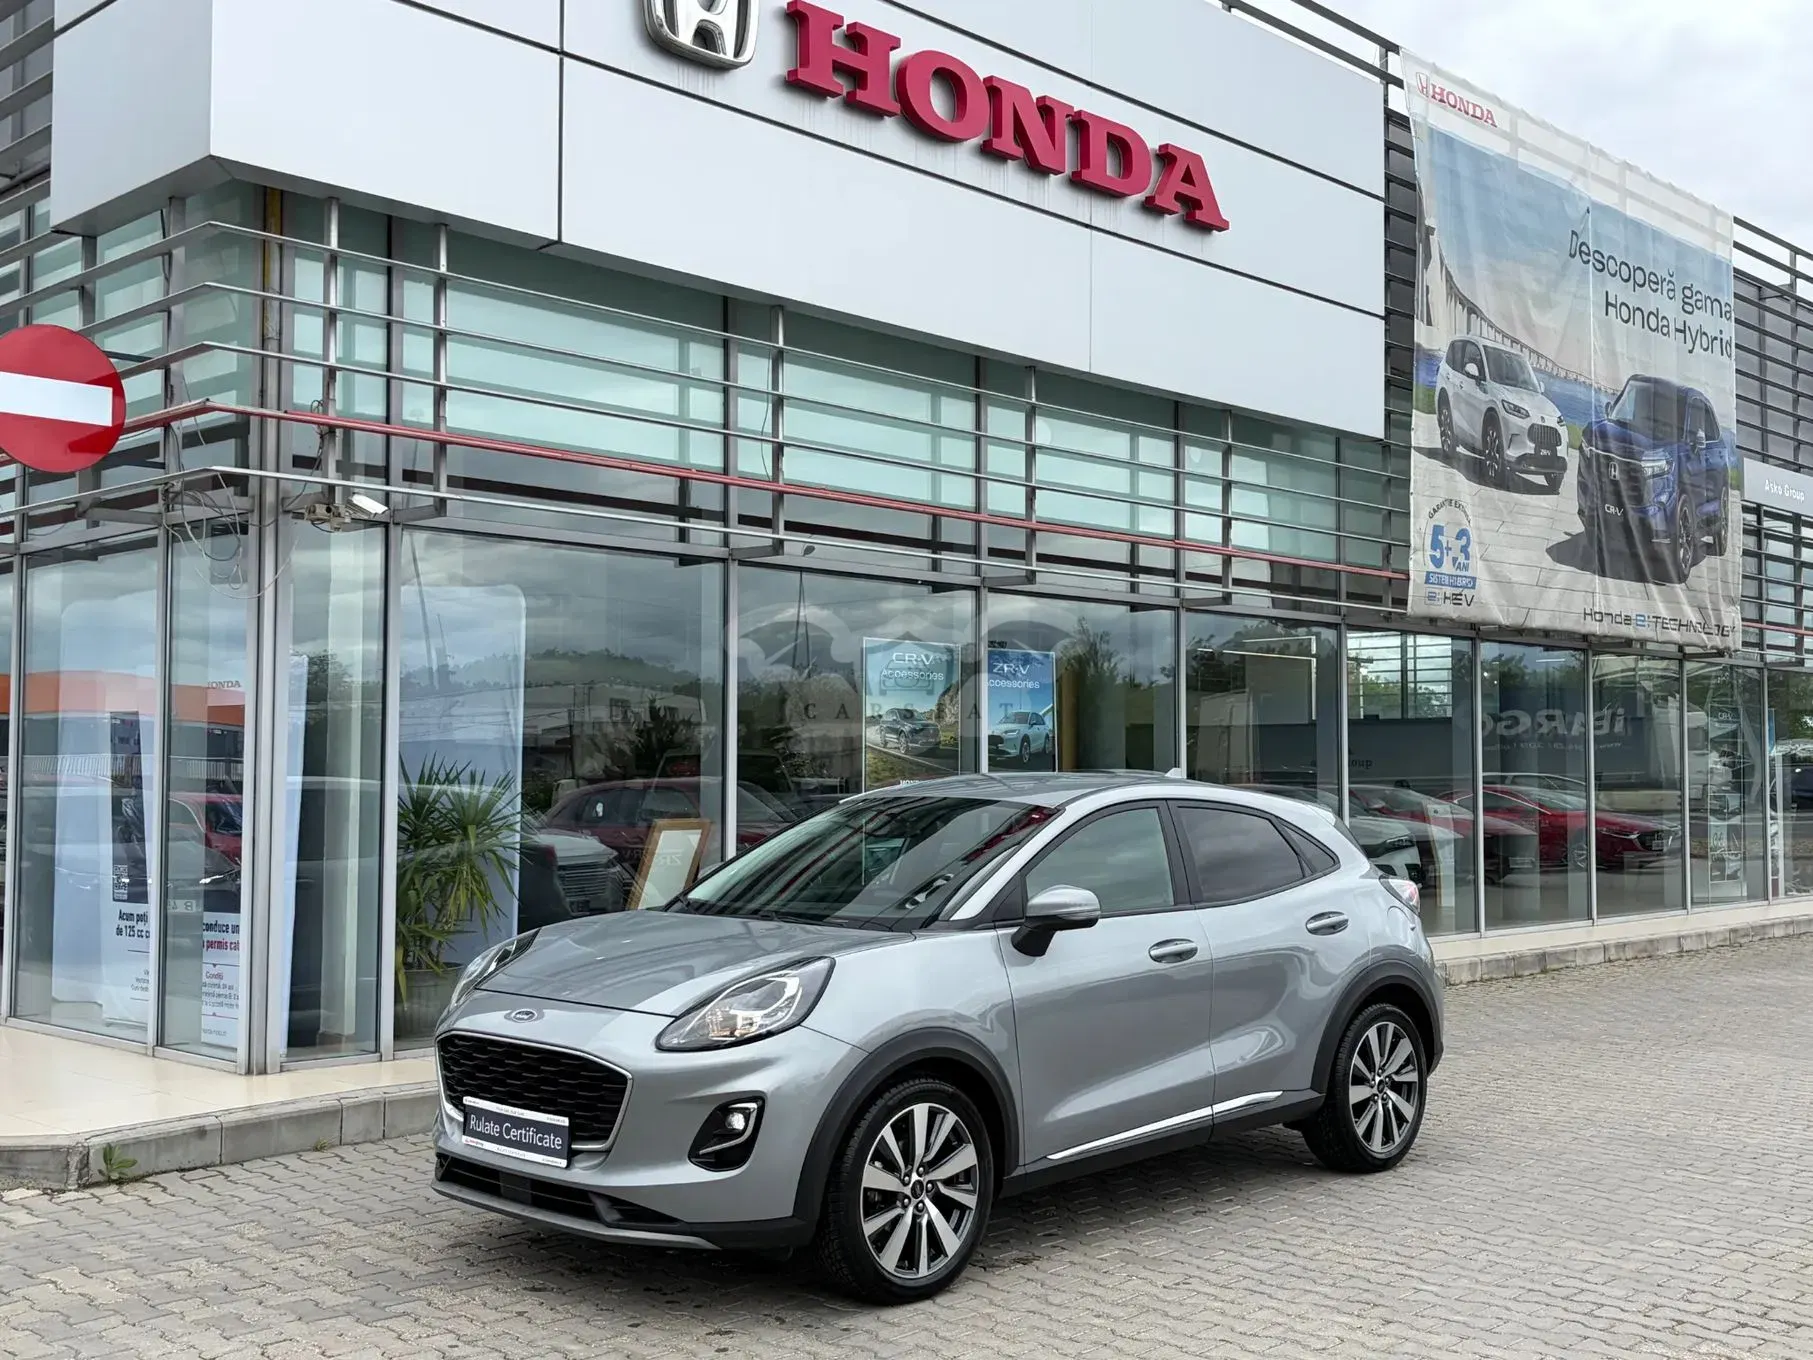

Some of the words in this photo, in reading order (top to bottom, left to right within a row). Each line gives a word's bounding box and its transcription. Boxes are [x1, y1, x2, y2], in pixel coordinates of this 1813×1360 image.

[785, 0, 1230, 232] HONDA
[1431, 83, 1498, 128] HONDA
[1569, 230, 1676, 301] Descoperă
[1681, 283, 1734, 323] gama
[1605, 290, 1670, 338] Honda
[1674, 317, 1733, 361] Hybrid
[1583, 607, 1632, 626] Honda
[881, 668, 944, 681] Accessories
[118, 909, 134, 921] Acum
[116, 925, 123, 936] de
[124, 925, 136, 937] 125
[206, 939, 228, 951] permis
[470, 1114, 500, 1137] Rulate
[502, 1122, 563, 1150] Certificate
